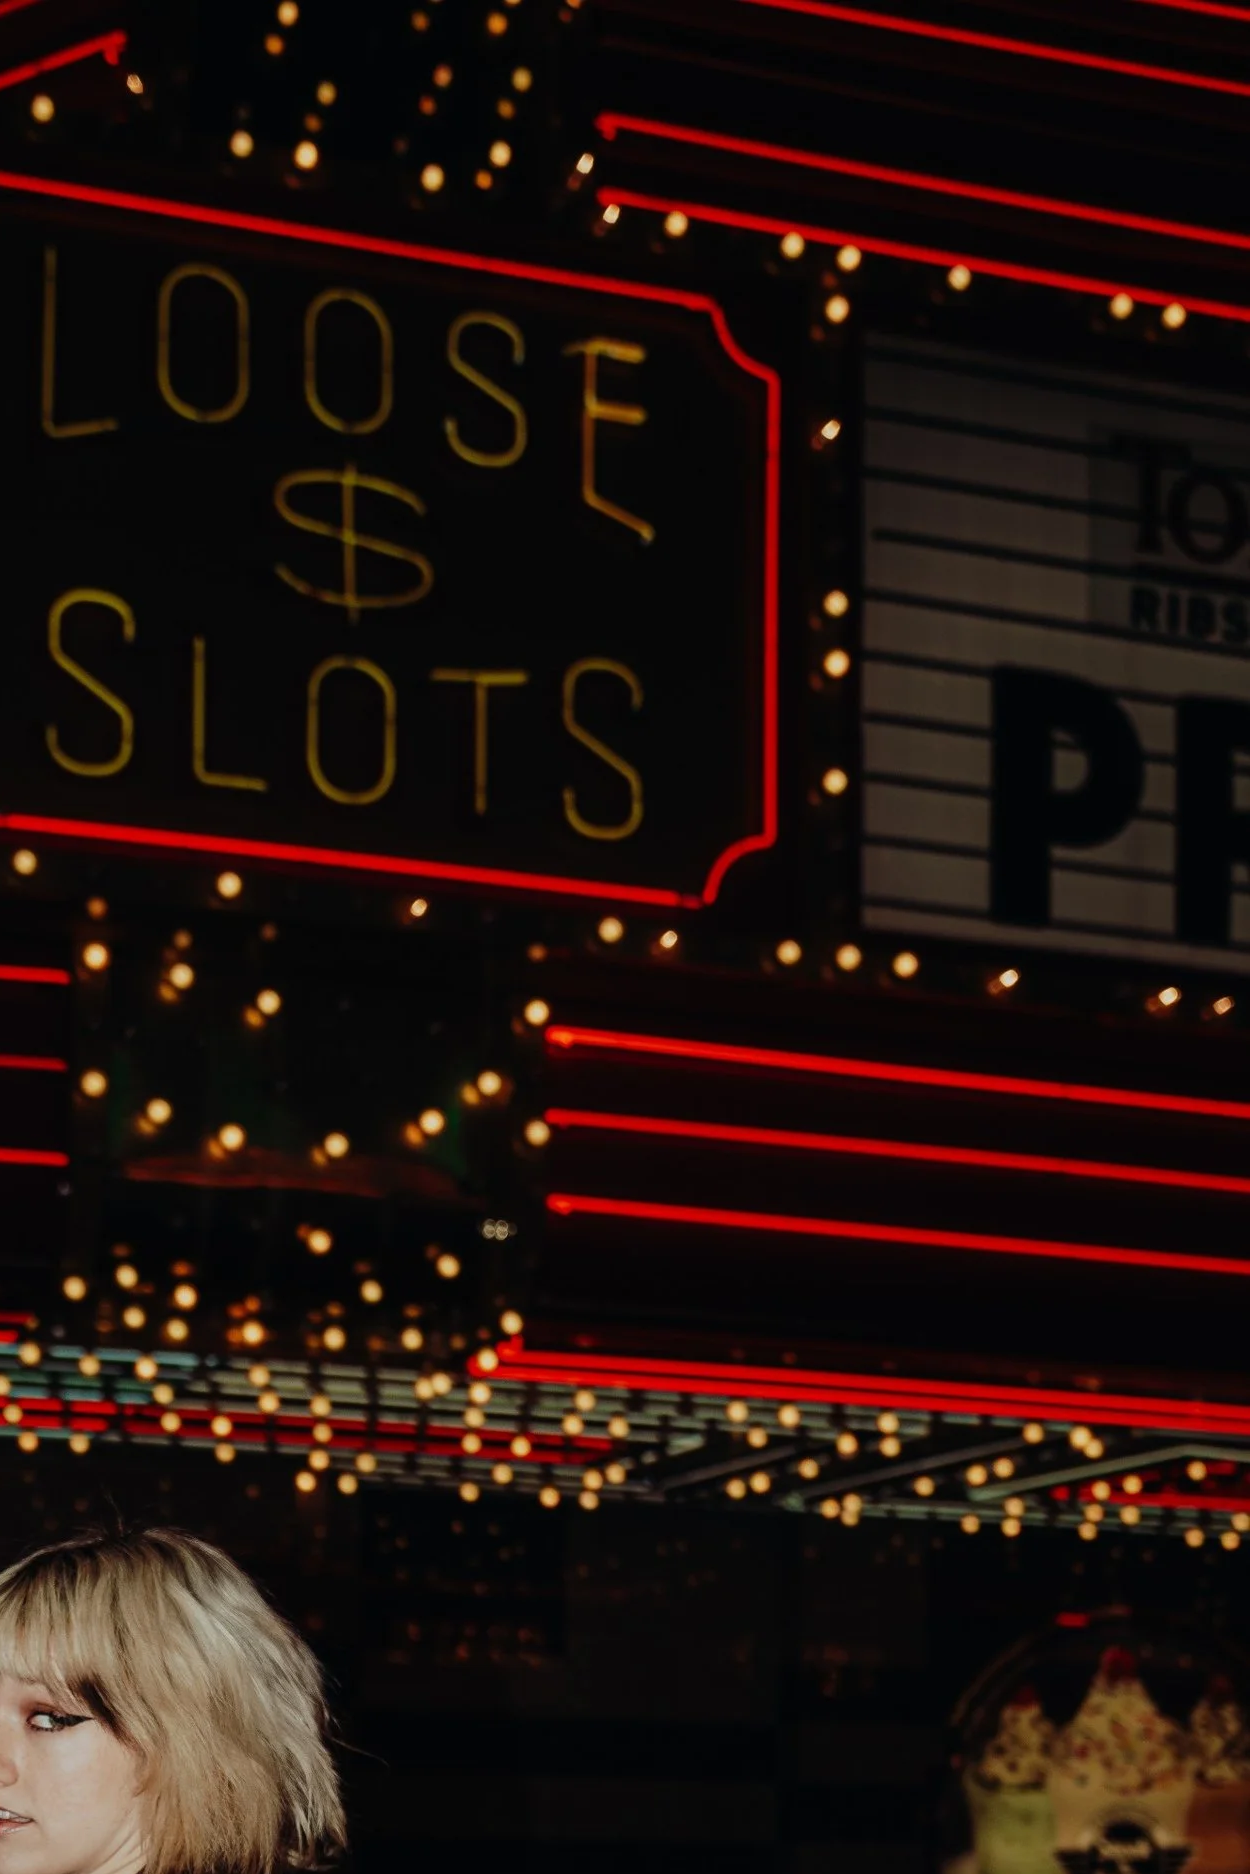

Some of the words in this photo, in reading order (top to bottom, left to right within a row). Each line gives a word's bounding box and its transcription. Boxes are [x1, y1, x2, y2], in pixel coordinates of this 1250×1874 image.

[40, 243, 656, 547] LOOSE
[272, 460, 435, 625] $
[44, 584, 646, 842] SLOTS
